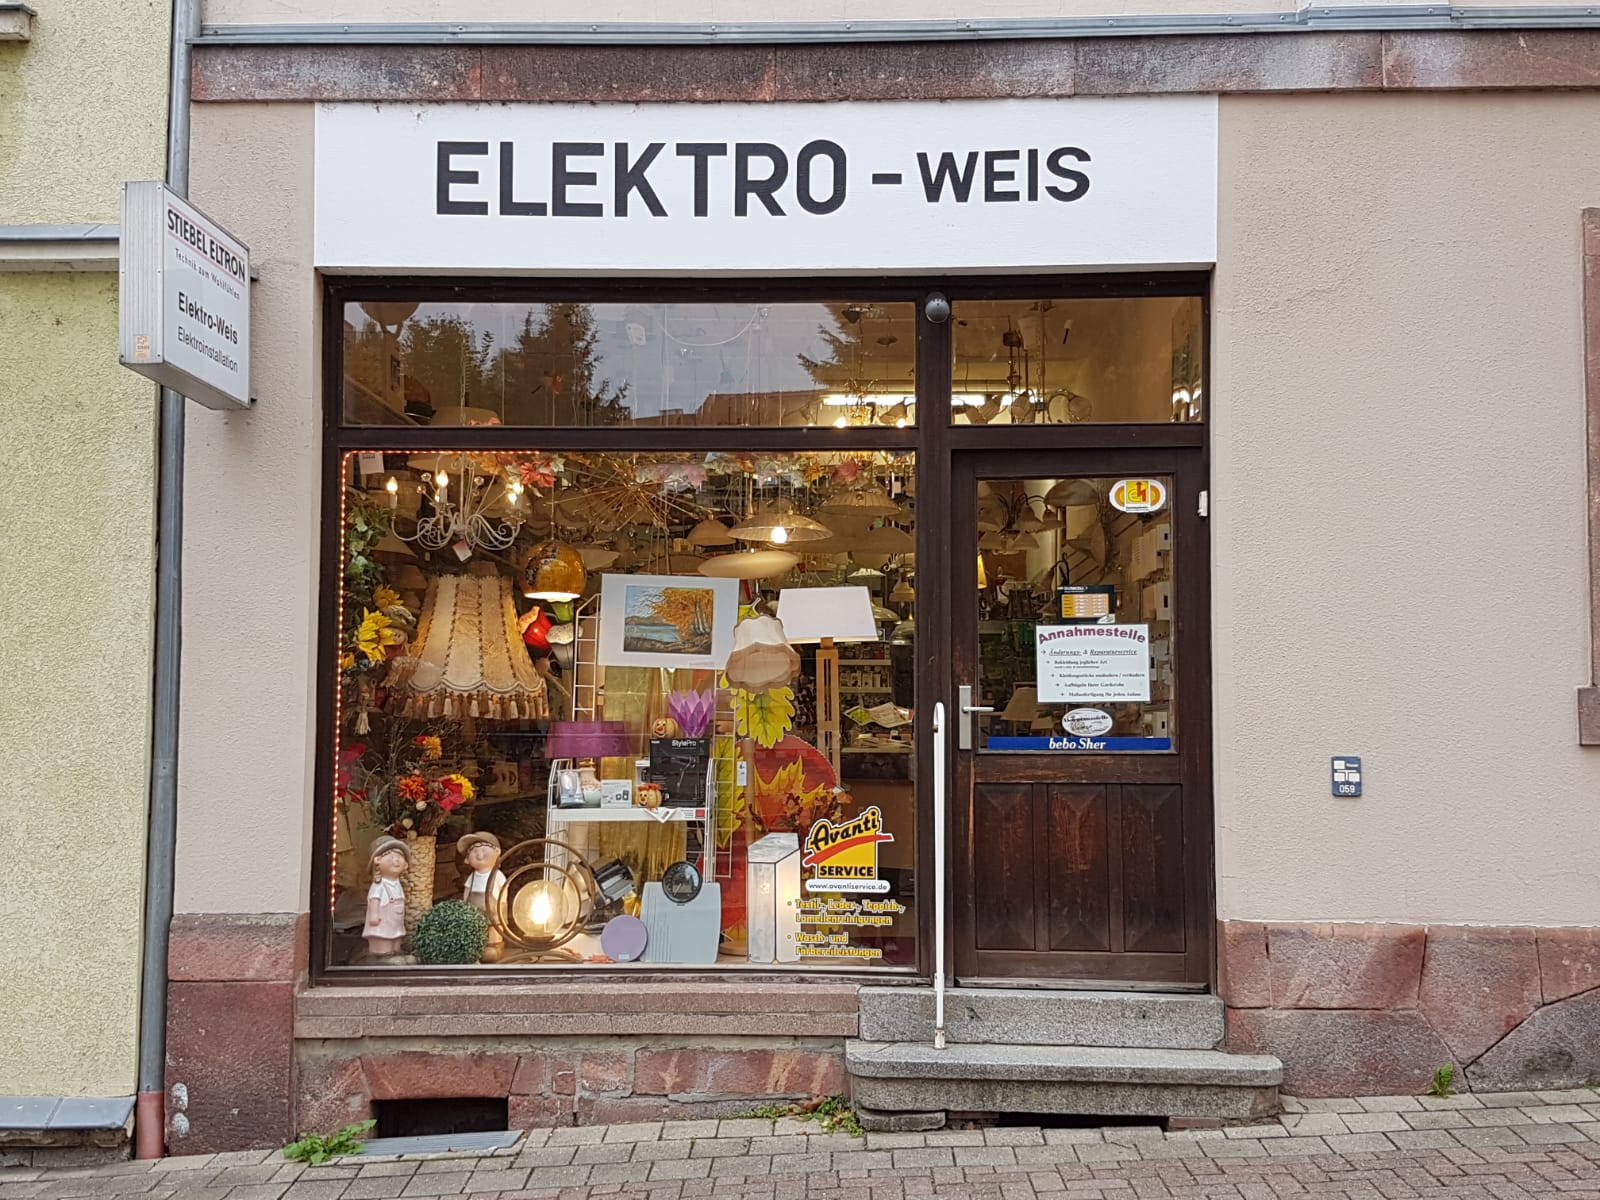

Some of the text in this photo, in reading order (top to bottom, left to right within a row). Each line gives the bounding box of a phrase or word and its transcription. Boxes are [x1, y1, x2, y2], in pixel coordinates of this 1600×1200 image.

[436, 139, 847, 217] ELEKTRO
[167, 208, 246, 283] STIEBEL ELTRON
[174, 248, 198, 271] Technik
[198, 266, 210, 280] zum
[177, 291, 239, 345] Elektro-Weis
[177, 325, 239, 374] Elektroinstallation
[1038, 626, 1146, 645] Annahmestelle
[1049, 737, 1107, 750] bebo Sher
[1339, 784, 1356, 794] 059
[810, 809, 878, 851] Avanti
[819, 865, 874, 877] SERVICE
[808, 881, 888, 891] www.avantiservice.de
[795, 913, 893, 927] Lamellenreinigungen
[830, 932, 849, 944] und
[795, 946, 882, 960] Färbereileistungen
